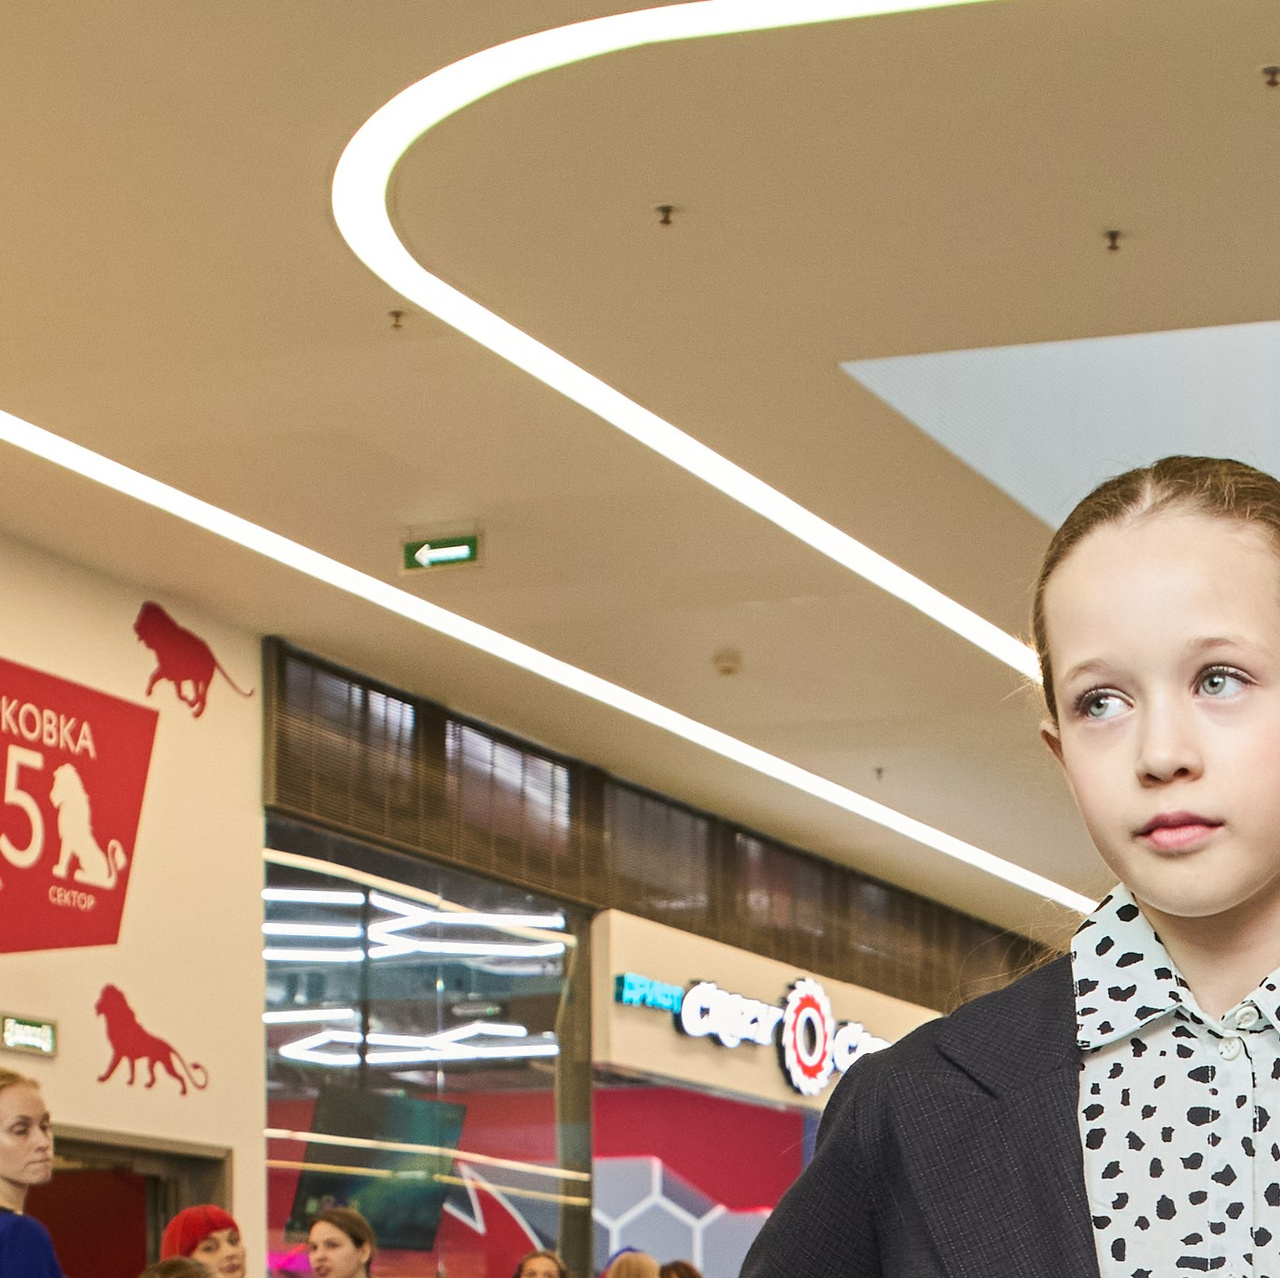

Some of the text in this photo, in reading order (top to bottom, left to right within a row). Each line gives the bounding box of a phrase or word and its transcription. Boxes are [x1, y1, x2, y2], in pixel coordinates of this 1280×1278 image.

[1, 696, 97, 759] КОВКА
[0, 744, 44, 869] 5
[49, 886, 95, 911] СЕКТОР
